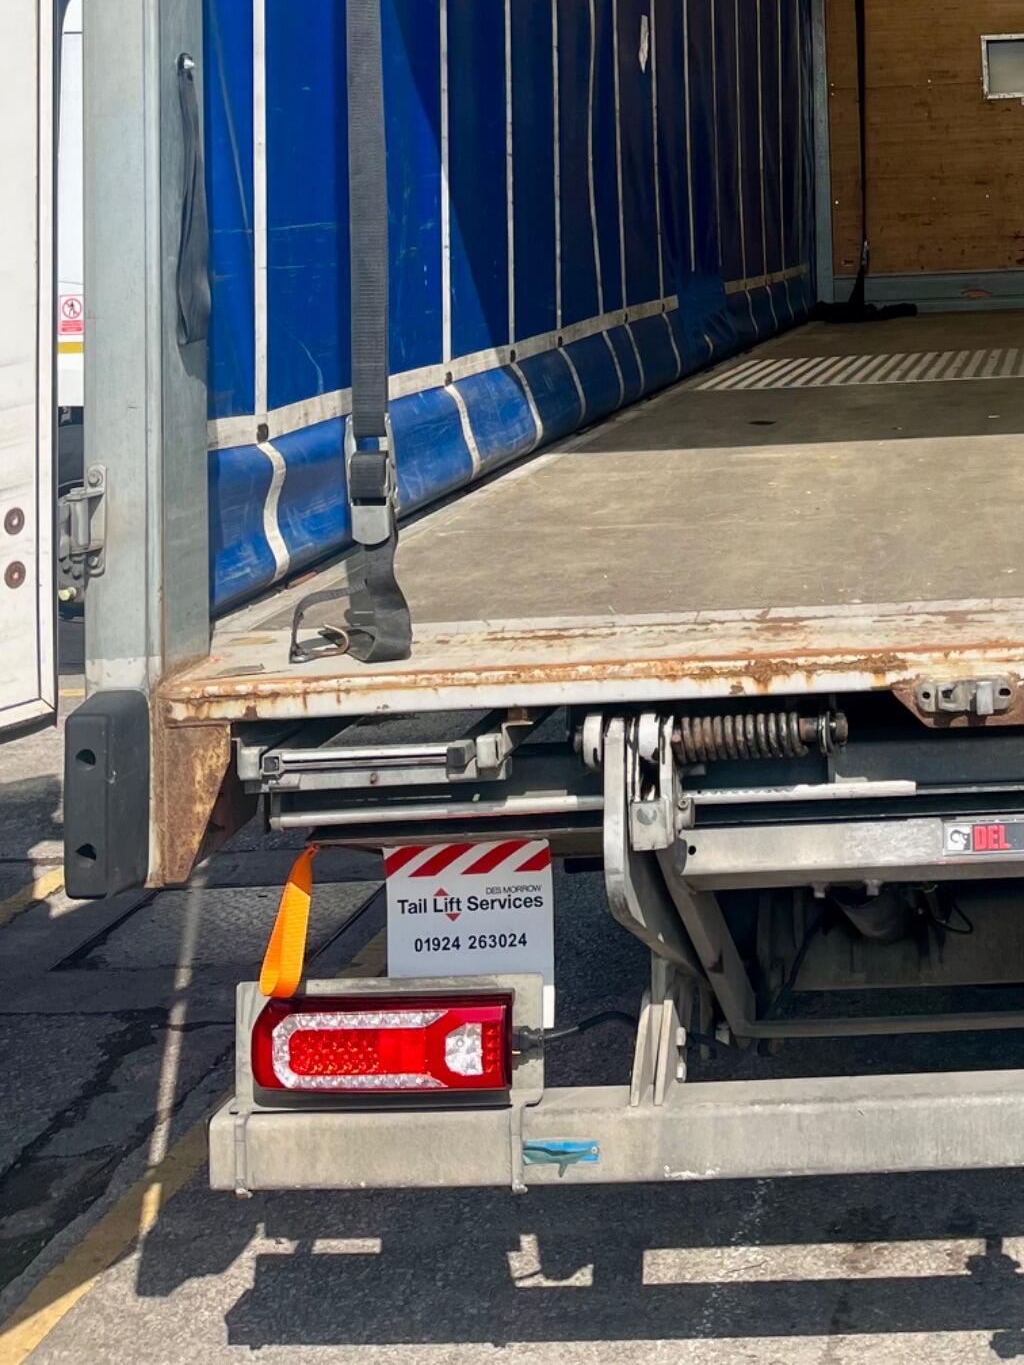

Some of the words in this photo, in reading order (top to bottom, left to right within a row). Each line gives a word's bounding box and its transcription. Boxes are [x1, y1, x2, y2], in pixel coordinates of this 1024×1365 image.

[972, 825, 1011, 852] DEL
[486, 886, 502, 895] DES
[503, 884, 542, 894] MORROW
[397, 898, 428, 915] Tail
[433, 897, 462, 913] Lift
[466, 894, 544, 912] Services
[414, 936, 461, 952] 01924
[468, 932, 528, 949] 263024
